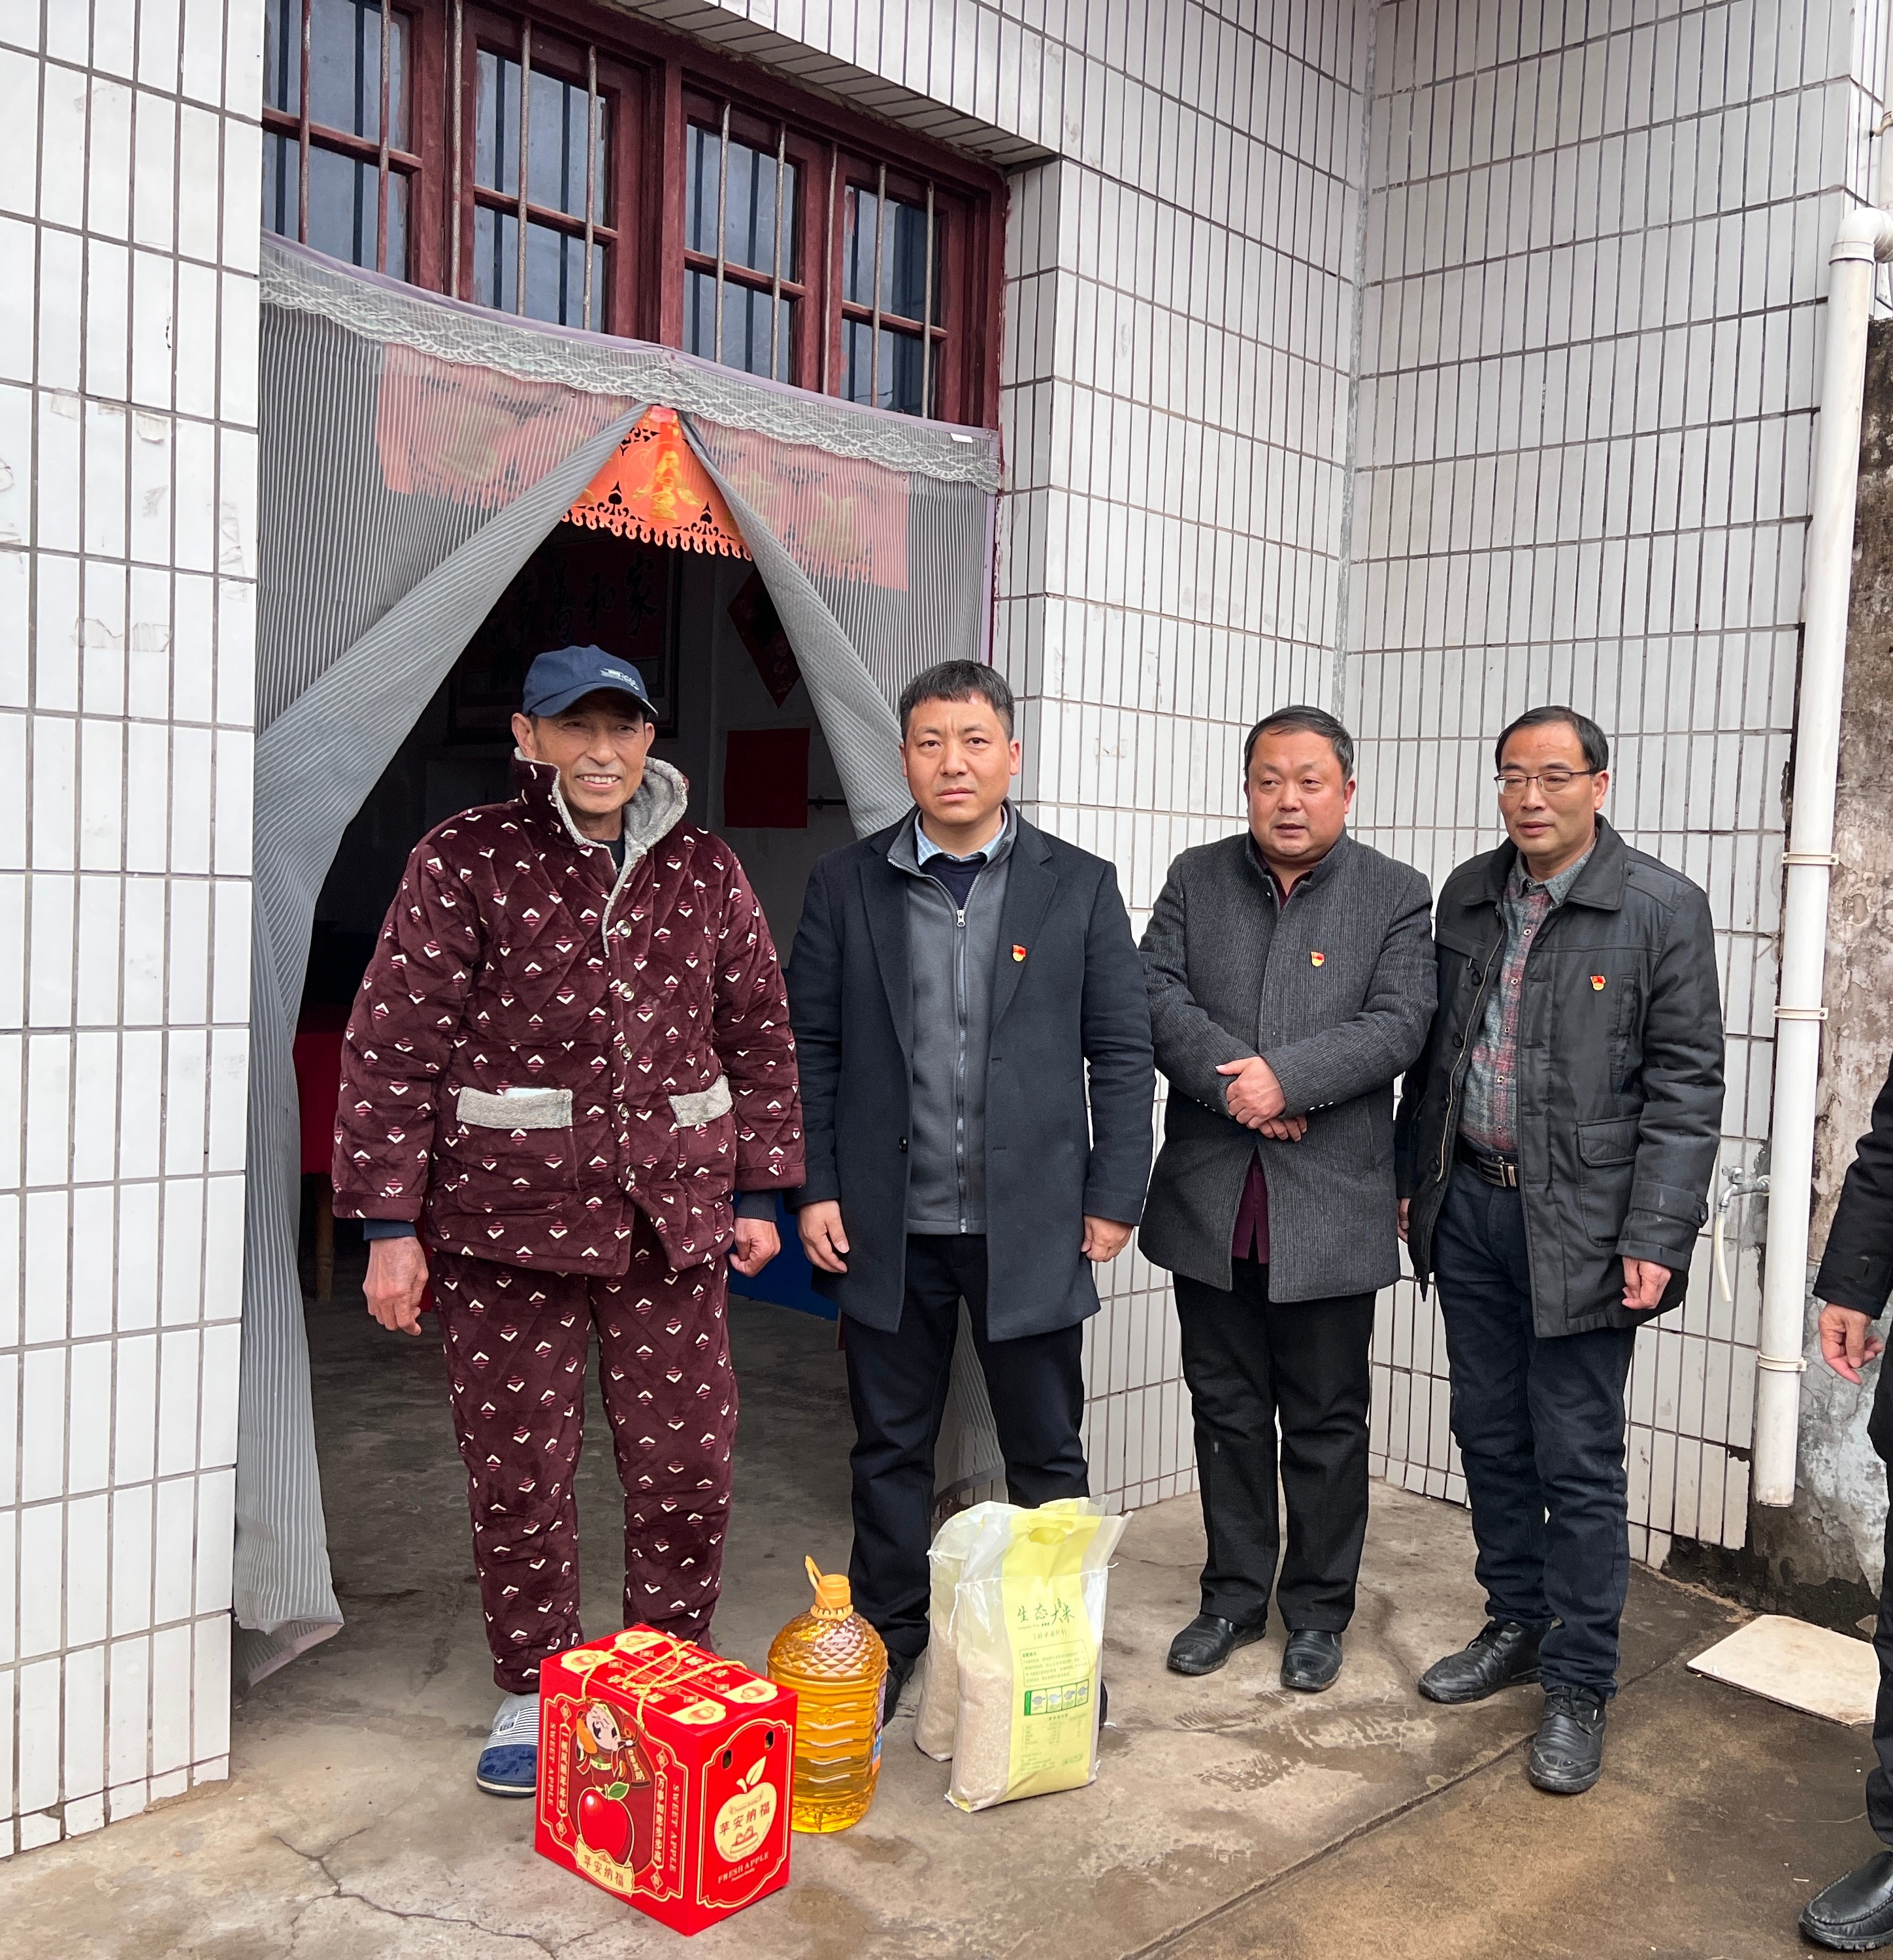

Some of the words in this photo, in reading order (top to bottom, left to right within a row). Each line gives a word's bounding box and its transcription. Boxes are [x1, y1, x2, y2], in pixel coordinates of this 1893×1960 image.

[1017, 1603, 1075, 1625] 生态大米
[670, 1785, 680, 1827] SWEET
[719, 1801, 770, 1836] 苹安纳福
[668, 1831, 678, 1873] APPLE
[717, 1865, 743, 1884] FRESH
[744, 1852, 769, 1870] APPLE
[583, 1855, 625, 1887] 苹安纳福
